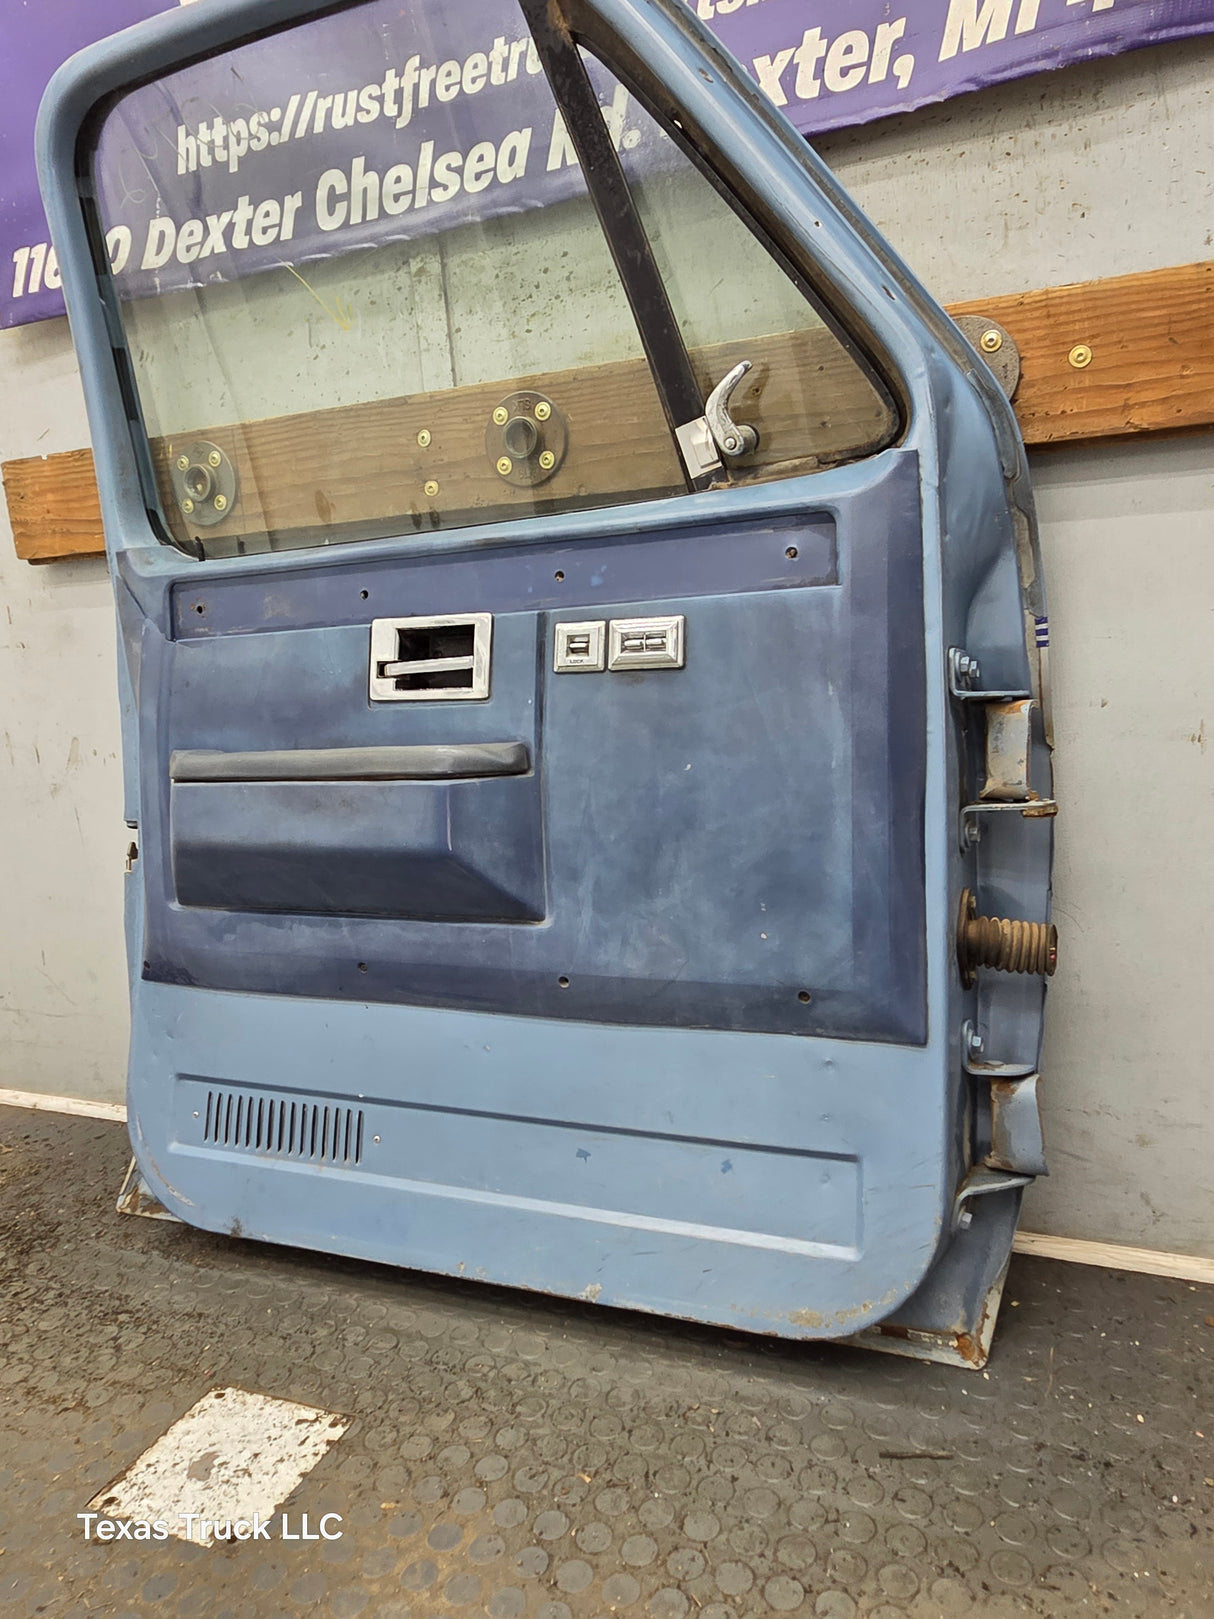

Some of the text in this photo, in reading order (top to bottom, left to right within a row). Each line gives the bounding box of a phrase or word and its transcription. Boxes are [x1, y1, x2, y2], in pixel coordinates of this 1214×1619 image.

[12, 224, 133, 298] 1160
[141, 188, 302, 271] Dexter
[315, 127, 533, 232] Chelsea
[750, 16, 915, 107] xter,
